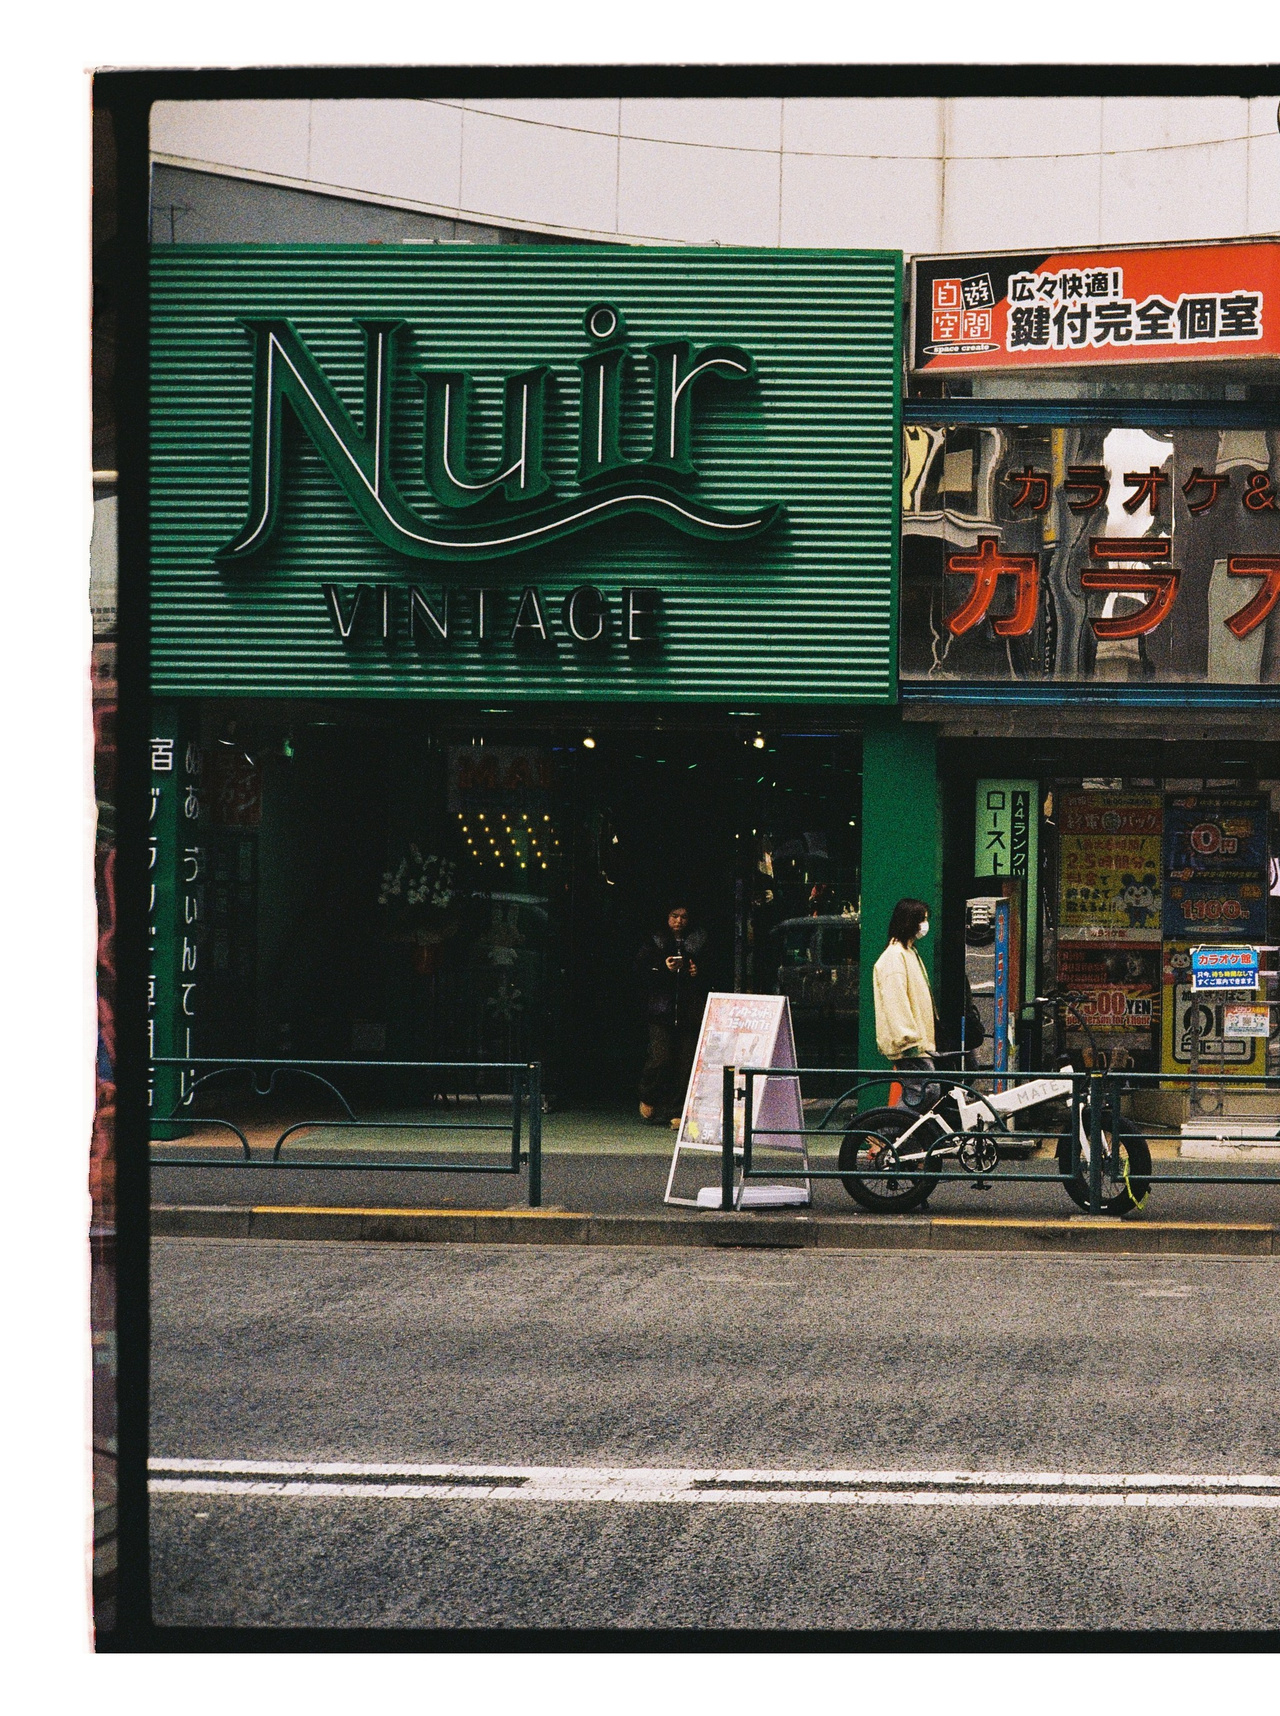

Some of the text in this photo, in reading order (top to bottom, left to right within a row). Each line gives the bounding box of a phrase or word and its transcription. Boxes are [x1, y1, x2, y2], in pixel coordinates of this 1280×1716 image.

[935, 277, 992, 308] 自遊
[934, 311, 991, 341] 空間
[1010, 295, 1260, 349] 鍵付完全個室
[934, 344, 990, 353] space create
[213, 302, 785, 562] Nuir
[321, 583, 662, 643] VINTAGE
[1198, 953, 1252, 965] カラオケ館
[1126, 1000, 1151, 1014] YEN
